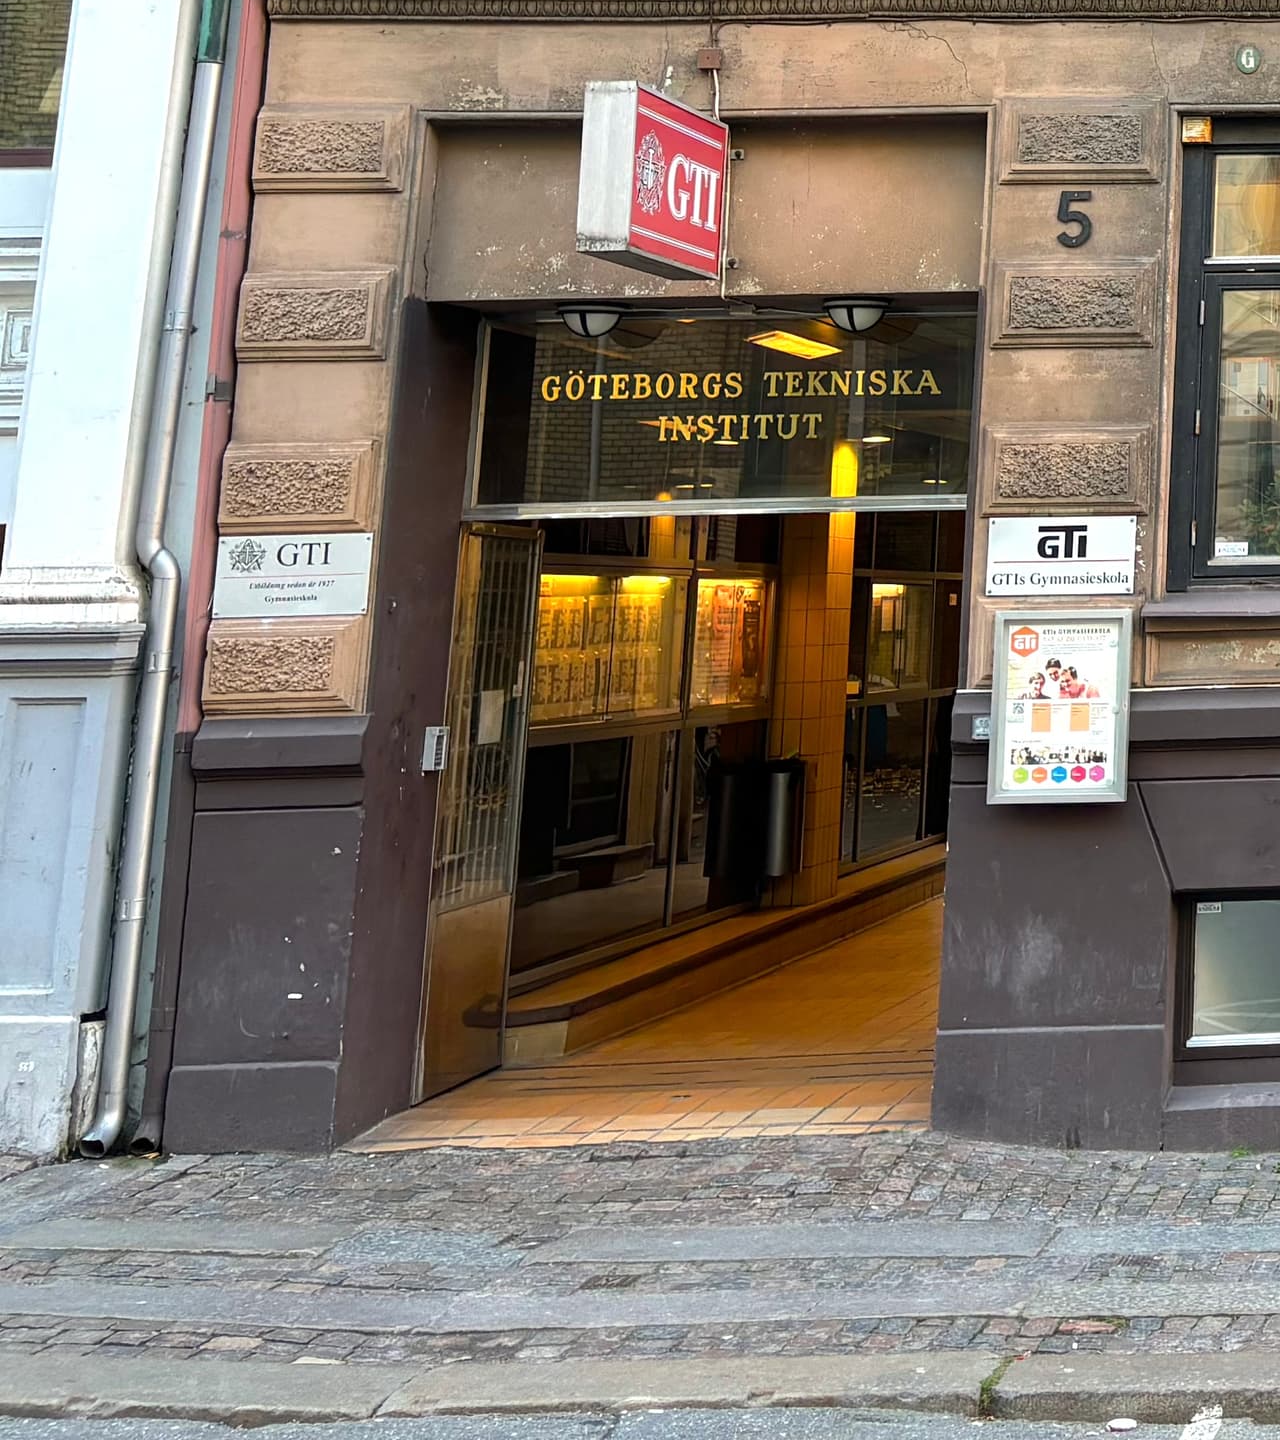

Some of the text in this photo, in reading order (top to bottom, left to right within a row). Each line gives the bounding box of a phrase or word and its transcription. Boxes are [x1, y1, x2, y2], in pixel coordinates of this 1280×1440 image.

[667, 153, 720, 233] GTI
[1057, 191, 1092, 248] 5
[541, 369, 942, 402] GÖTEBORGS TEKNISKA
[657, 413, 823, 443] INSTITUT
[276, 542, 332, 567] GTI
[1037, 525, 1088, 559] GTI
[992, 571, 1129, 588] GTIs Gymnasieskola
